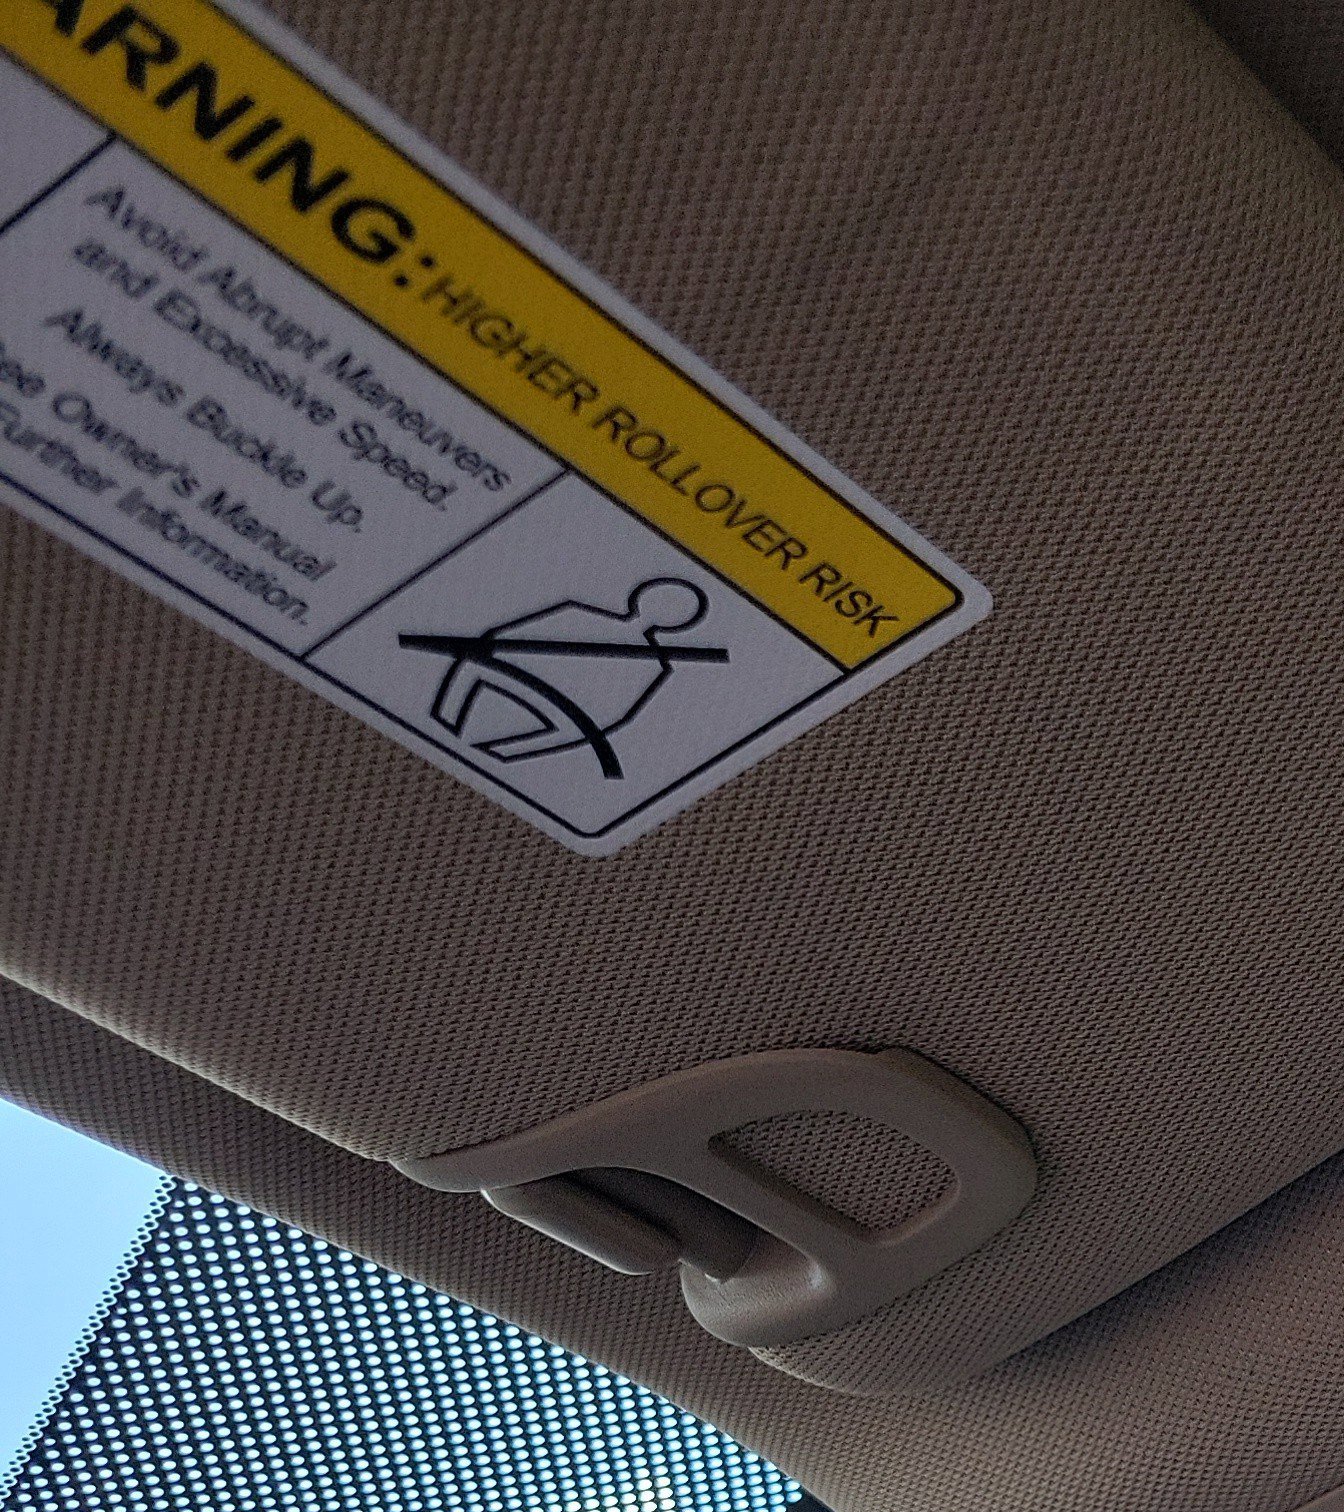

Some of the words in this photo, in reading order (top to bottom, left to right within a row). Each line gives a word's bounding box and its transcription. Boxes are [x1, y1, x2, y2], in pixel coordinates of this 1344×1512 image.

[0, 342, 46, 398] ee
[52, 391, 200, 499] Owner's
[200, 487, 337, 581] Manual
[44, 309, 186, 408] Always
[184, 397, 309, 489] Buckle
[311, 480, 364, 533] Up.
[72, 237, 160, 299] and
[152, 288, 337, 426] Excessive
[338, 419, 458, 511] Speed.
[84, 186, 208, 273] Avoid
[201, 266, 330, 362] Abrupt
[321, 352, 511, 491] Maneuvers
[421, 276, 599, 415] HIGHER
[591, 405, 808, 571] ROLLOVER
[800, 562, 900, 638] RISK
[115, 486, 310, 625] Information.
